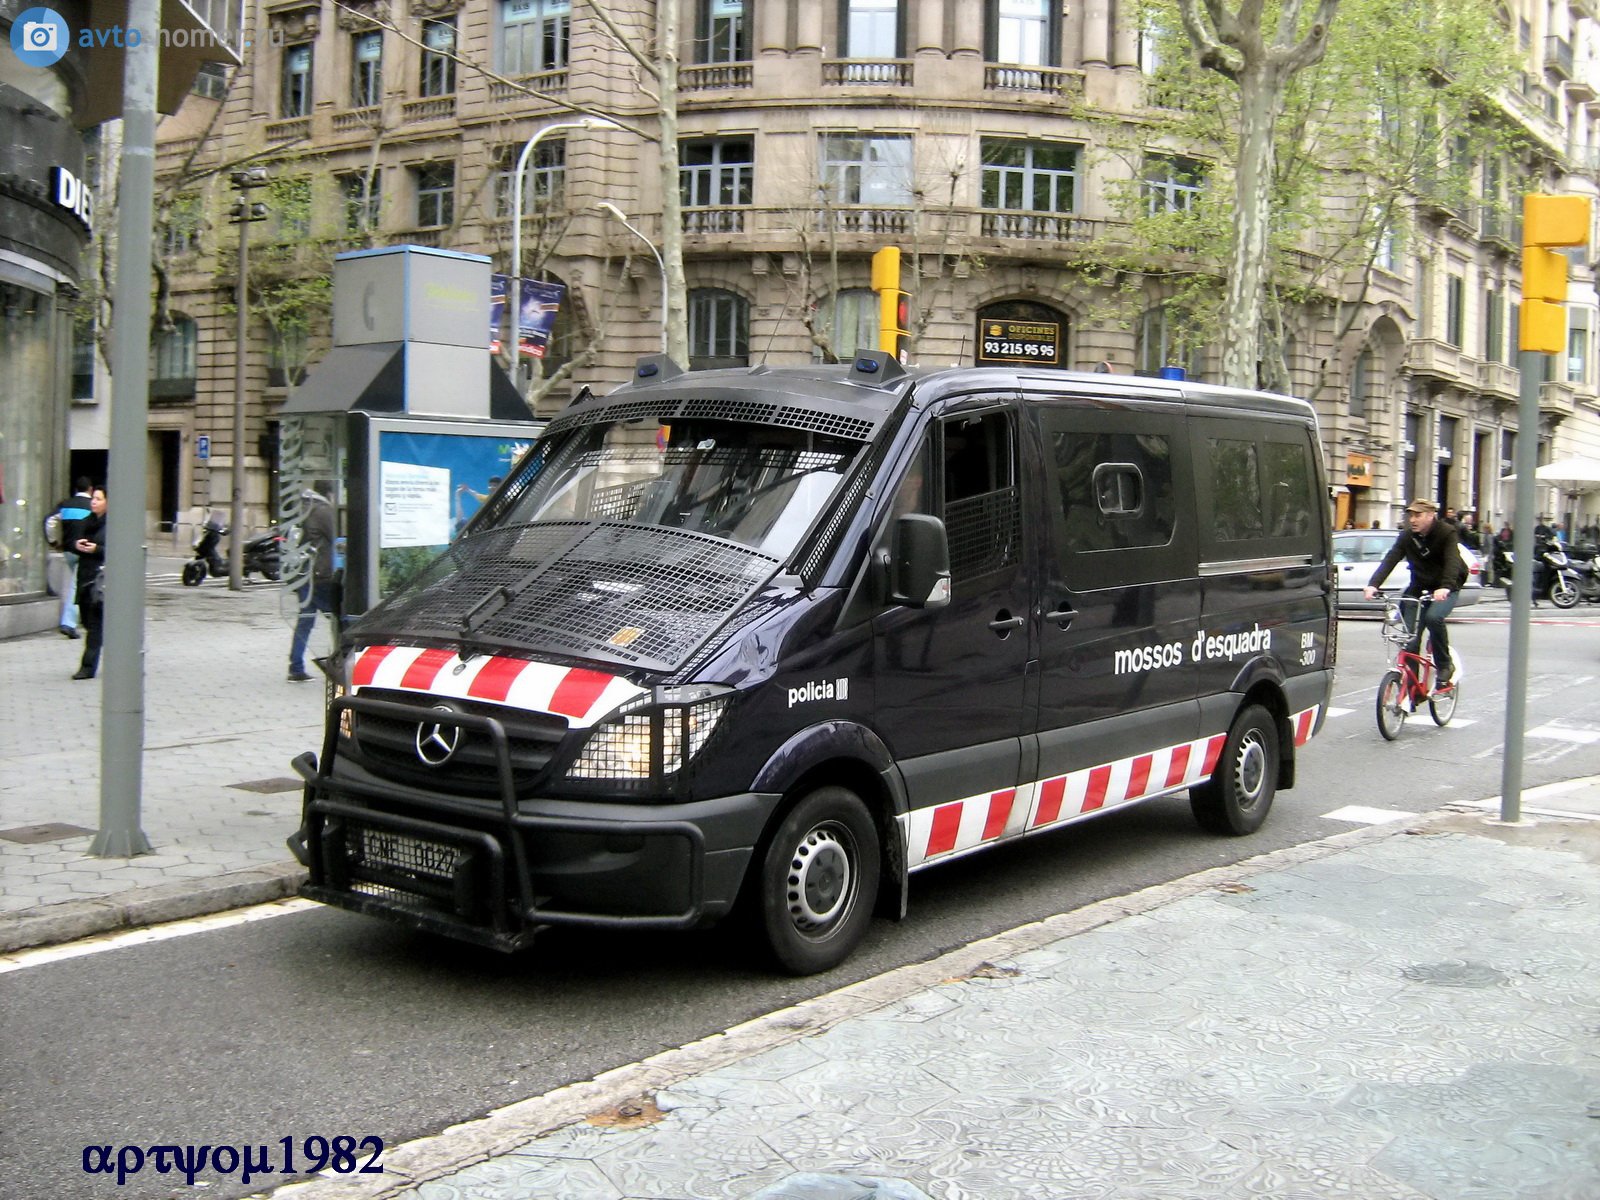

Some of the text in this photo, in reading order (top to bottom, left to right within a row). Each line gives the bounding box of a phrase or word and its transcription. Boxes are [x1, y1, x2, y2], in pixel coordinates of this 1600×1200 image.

[1008, 325, 1055, 335] OFICINES
[984, 342, 1054, 356] 93 215 95 95
[1114, 623, 1272, 675] mossos d'esquadra
[1301, 631, 1314, 649] BM
[788, 679, 834, 708] policia
